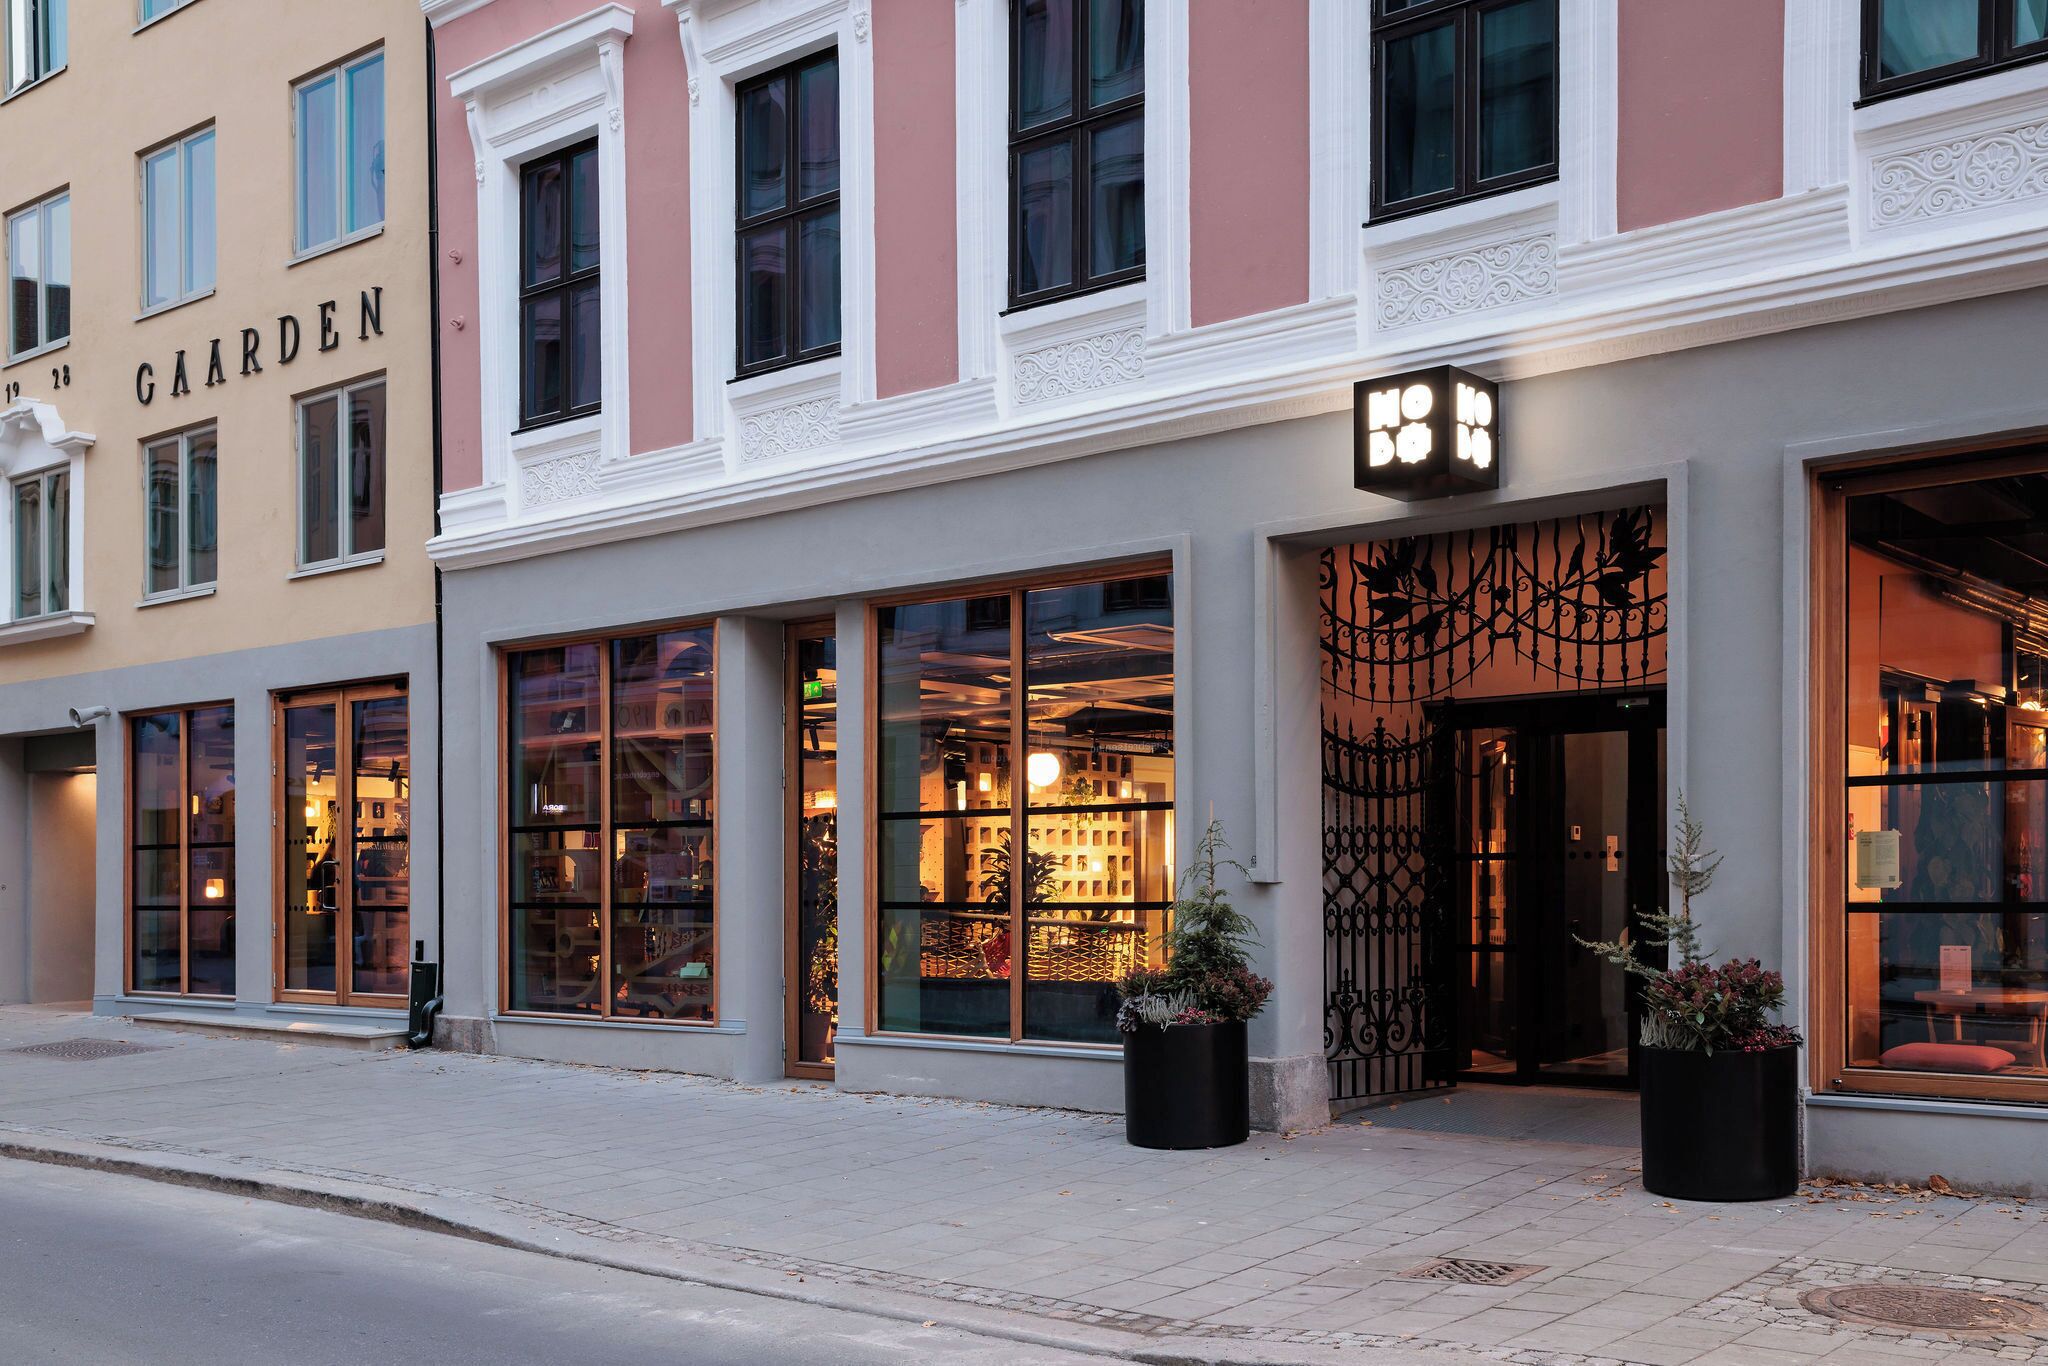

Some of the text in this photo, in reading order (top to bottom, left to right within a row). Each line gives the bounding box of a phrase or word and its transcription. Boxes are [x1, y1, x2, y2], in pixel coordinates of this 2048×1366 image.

[5, 364, 71, 404] 19 28
[136, 286, 384, 406] GAARDEN
